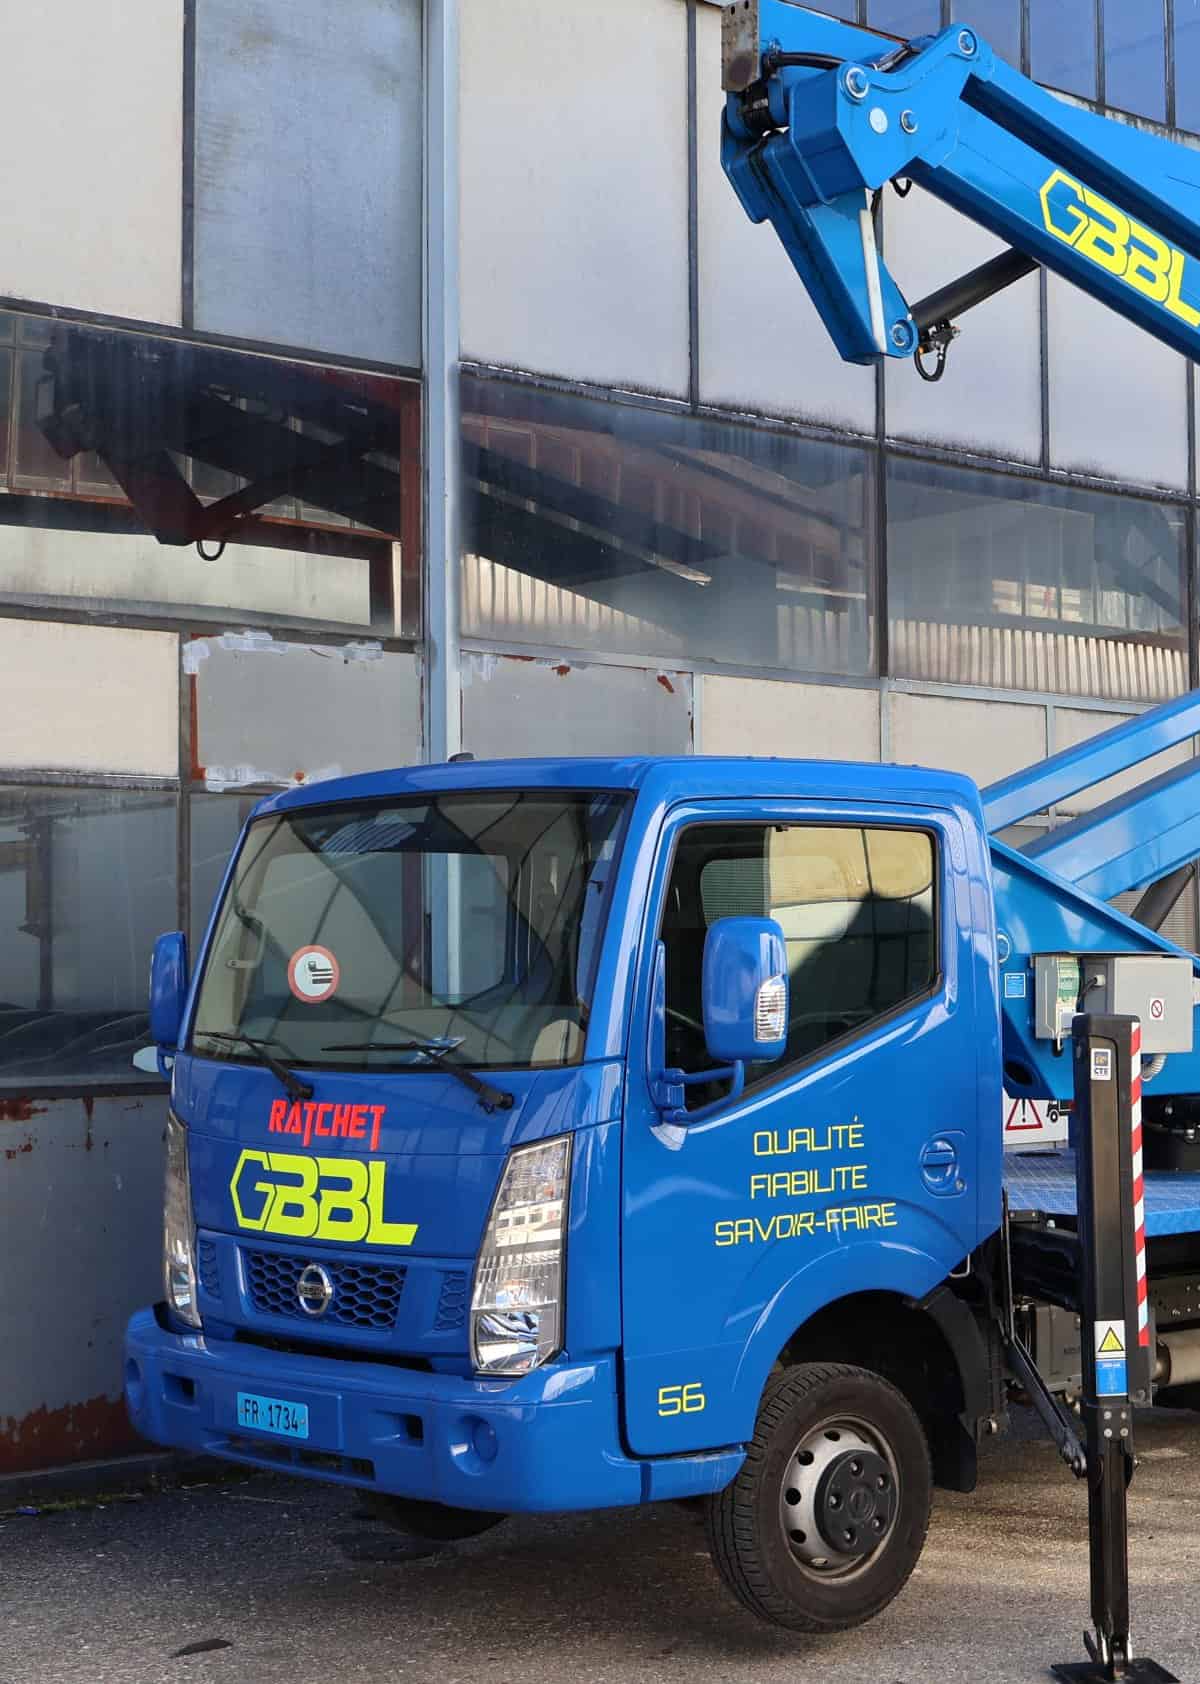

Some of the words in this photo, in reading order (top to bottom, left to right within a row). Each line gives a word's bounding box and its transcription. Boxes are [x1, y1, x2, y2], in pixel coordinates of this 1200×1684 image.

[269, 1100, 386, 1151] RATCHET
[753, 1115, 865, 1156] QUALITÉ
[750, 1164, 868, 1200] FIABILITE
[714, 1202, 898, 1247] SAVOIR-FAIRE
[657, 1383, 706, 1417] 56
